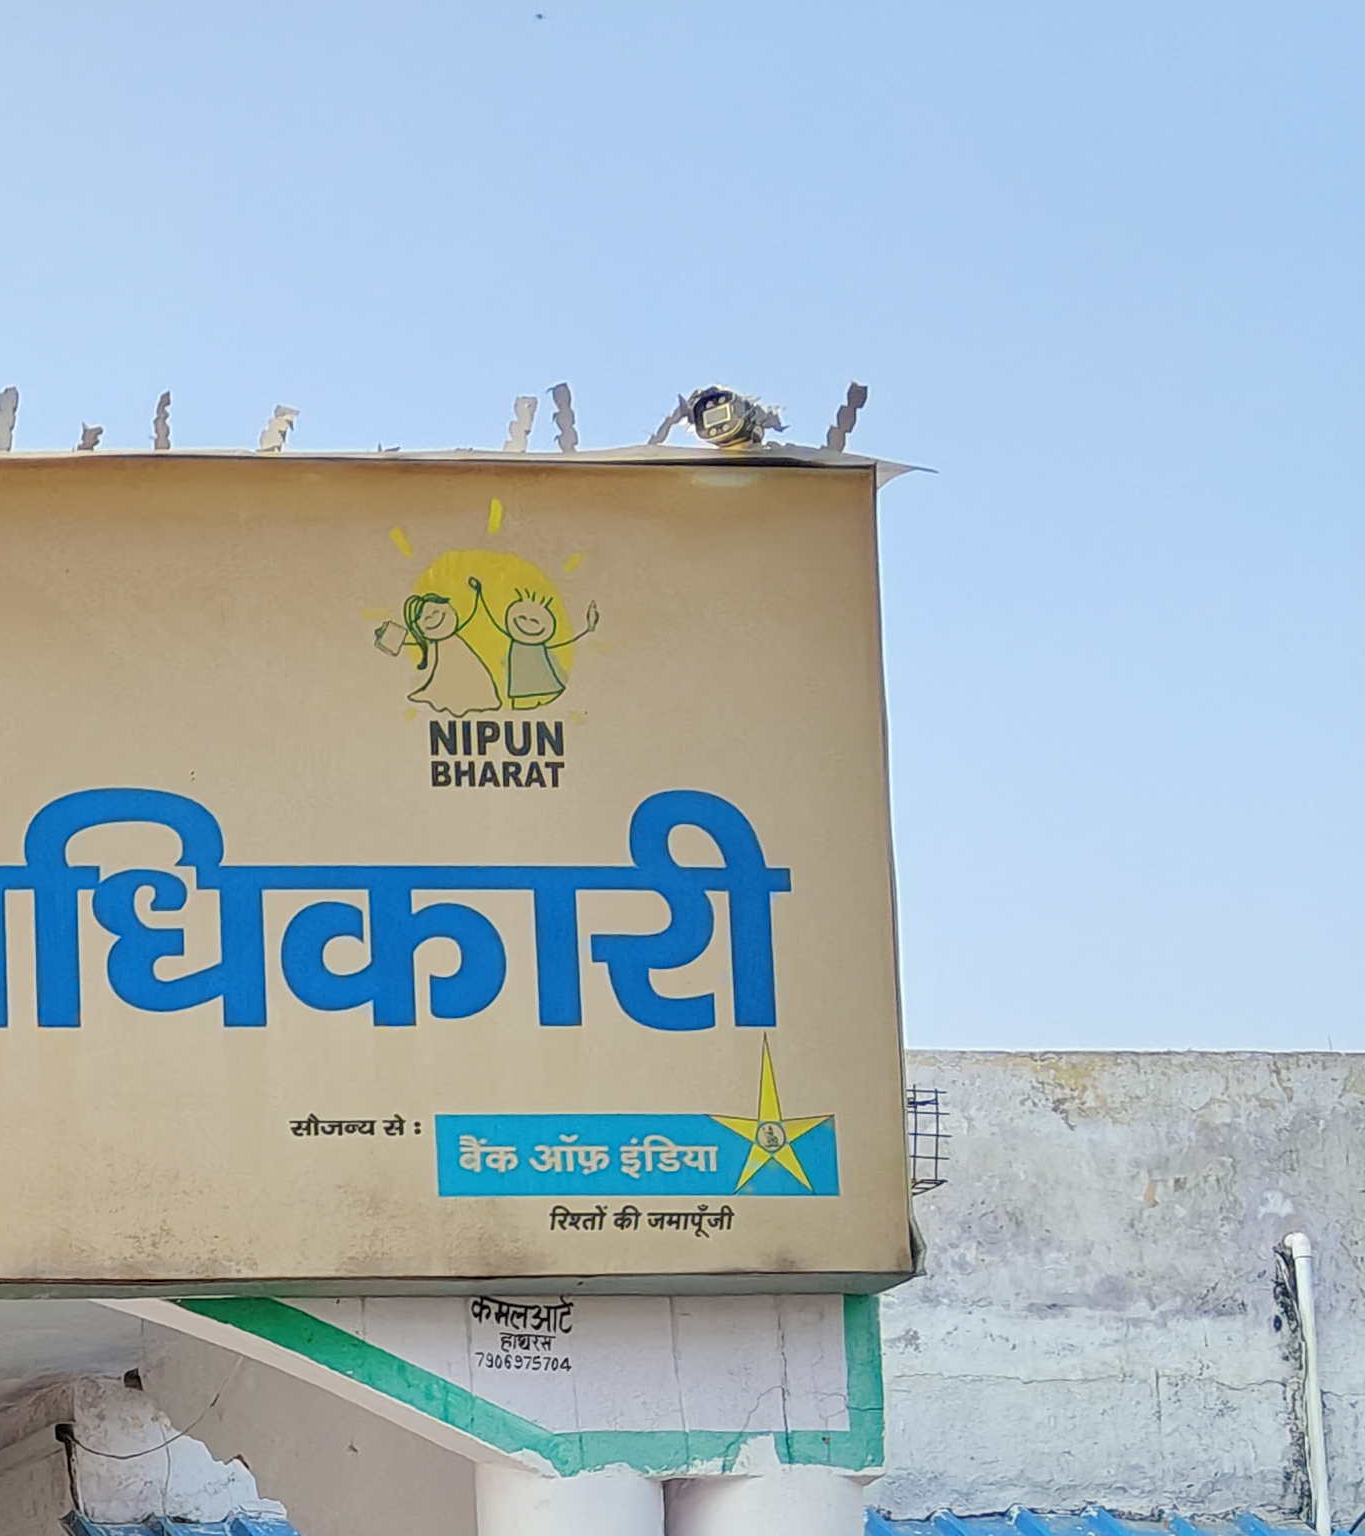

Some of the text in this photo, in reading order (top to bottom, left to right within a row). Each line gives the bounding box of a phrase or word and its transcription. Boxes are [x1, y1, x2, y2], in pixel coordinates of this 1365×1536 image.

[429, 720, 564, 757] NIPUN
[430, 760, 565, 789] BHARAT
[289, 1113, 377, 1137] सौजन्य
[458, 1134, 519, 1173] बैंक
[619, 1134, 719, 1179] इंडिया
[549, 1205, 608, 1231] रिश्तों
[613, 1205, 642, 1231] की
[474, 1352, 573, 1373] 7906975704
